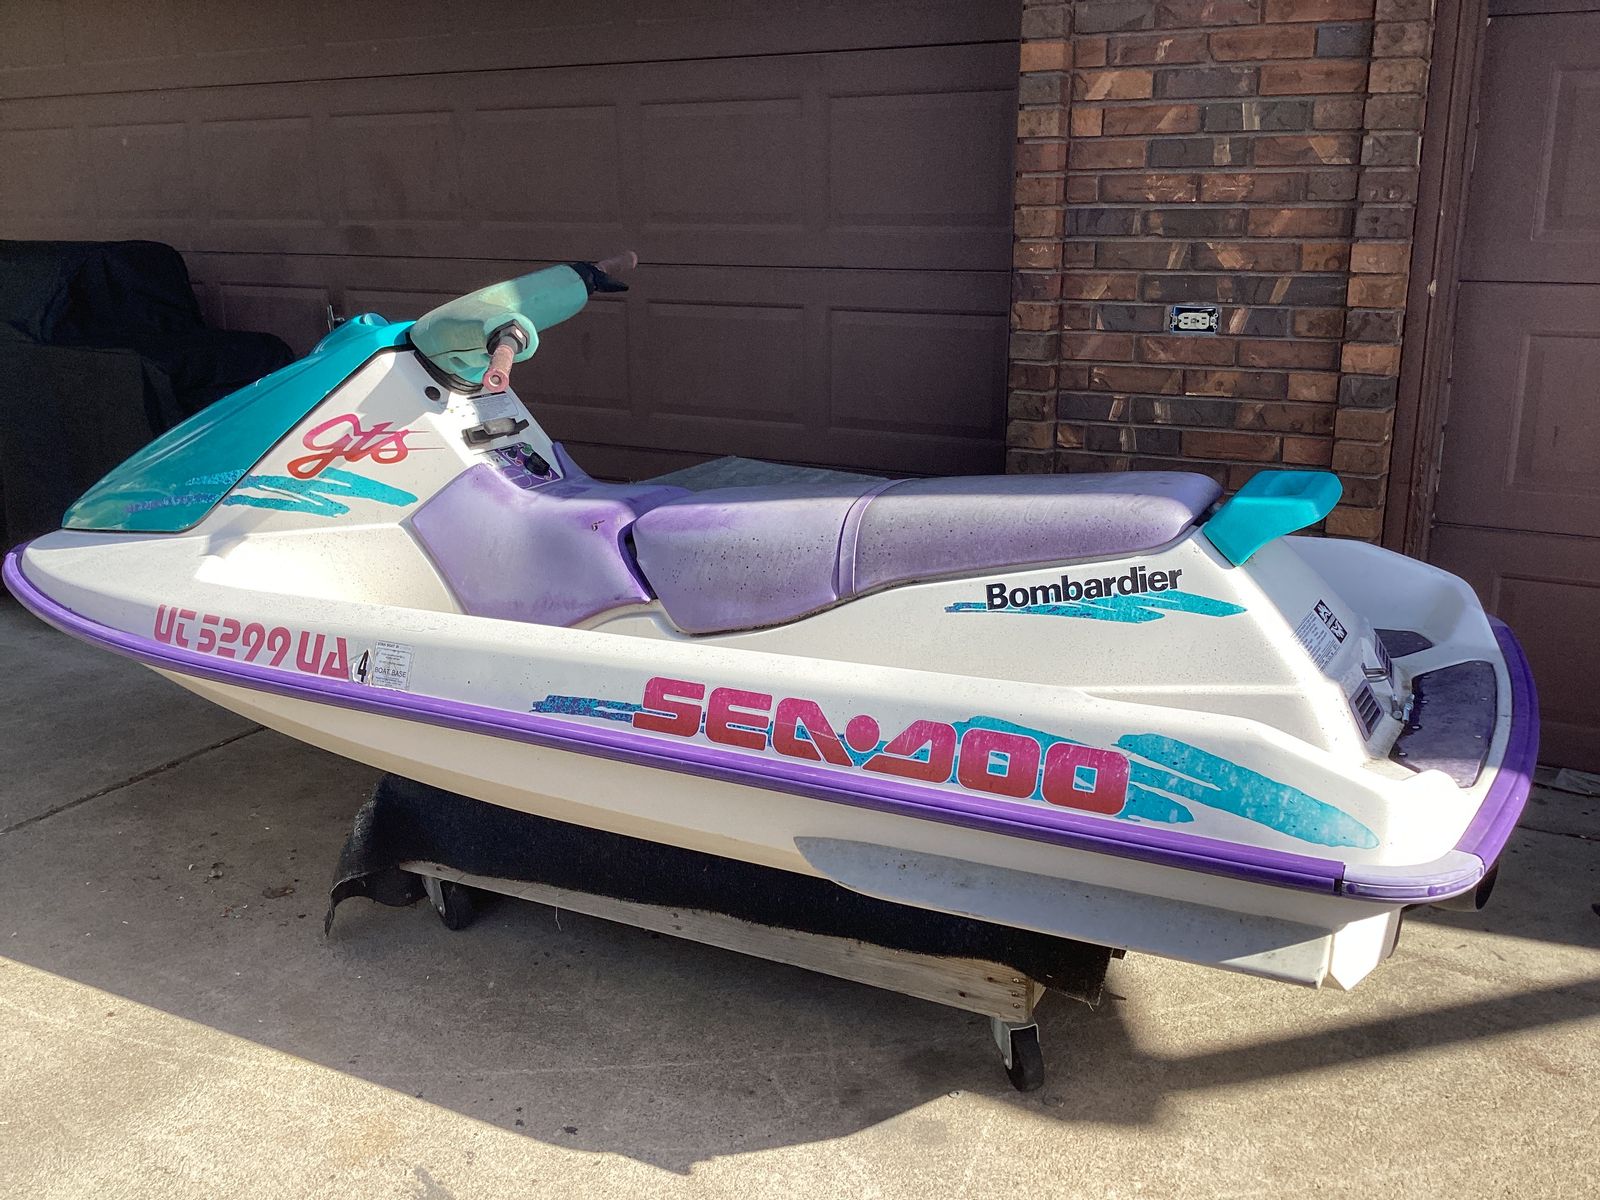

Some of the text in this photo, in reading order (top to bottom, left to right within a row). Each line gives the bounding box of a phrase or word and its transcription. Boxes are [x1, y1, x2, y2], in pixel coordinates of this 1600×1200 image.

[986, 565, 1182, 610] Bombardier
[197, 614, 291, 667] 5299
[296, 631, 349, 680] UA
[357, 649, 369, 682] 4
[374, 666, 407, 678] BOAT BASE
